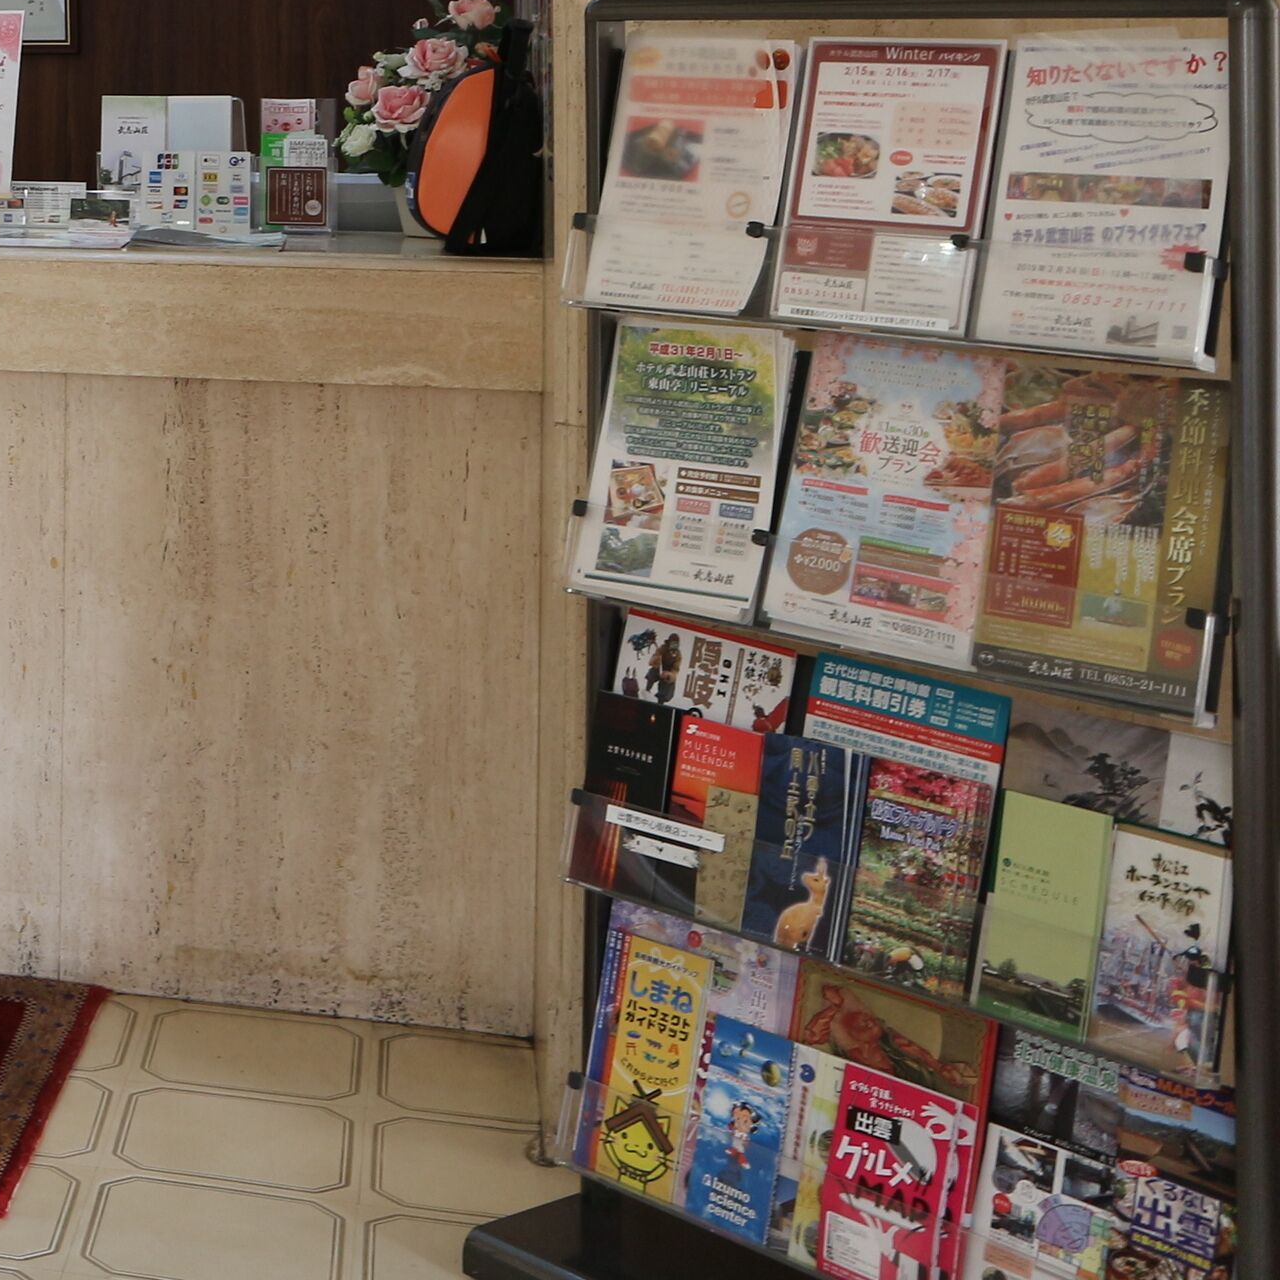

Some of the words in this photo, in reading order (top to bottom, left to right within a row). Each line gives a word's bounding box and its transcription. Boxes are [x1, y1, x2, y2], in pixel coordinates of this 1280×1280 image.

[885, 46, 937, 62] Winter
[938, 51, 982, 63] バイキング
[1025, 50, 1228, 88] 知りたくないですか？
[1102, 222, 1207, 243] のブライダルフェア
[1062, 292, 1187, 313] 0853-21-1111
[649, 342, 743, 361] 平成31年2月1日〜
[635, 361, 757, 382] ホテル武志山荘レストラン
[641, 376, 749, 397] 「東山亭」リニューアル
[859, 429, 942, 466] 歓送迎会
[878, 455, 918, 474] プラン
[1161, 387, 1211, 625] 季節料理会席プラン
[693, 568, 736, 586] 武志山荘
[683, 635, 723, 710] 隠岐
[822, 661, 933, 699] 古代出雲歴史博物館
[1079, 668, 1102, 683] TEL
[1103, 673, 1188, 698] 0853-21-1111
[818, 676, 928, 719] 観覧料割引券
[681, 749, 736, 770] CALENDAR
[683, 739, 737, 759] MUSEUM
[631, 970, 694, 1014] しまね
[625, 1012, 689, 1042] ガイドマップ
[626, 1000, 692, 1030] パーフェクト
[854, 1111, 893, 1141] 出雲
[836, 1135, 914, 1187] グルメ
[709, 1190, 757, 1219] science
[712, 1176, 751, 1204] izumo
[855, 1175, 931, 1224] MAP
[707, 1204, 748, 1228] center
[1130, 1194, 1217, 1260] 出雲
